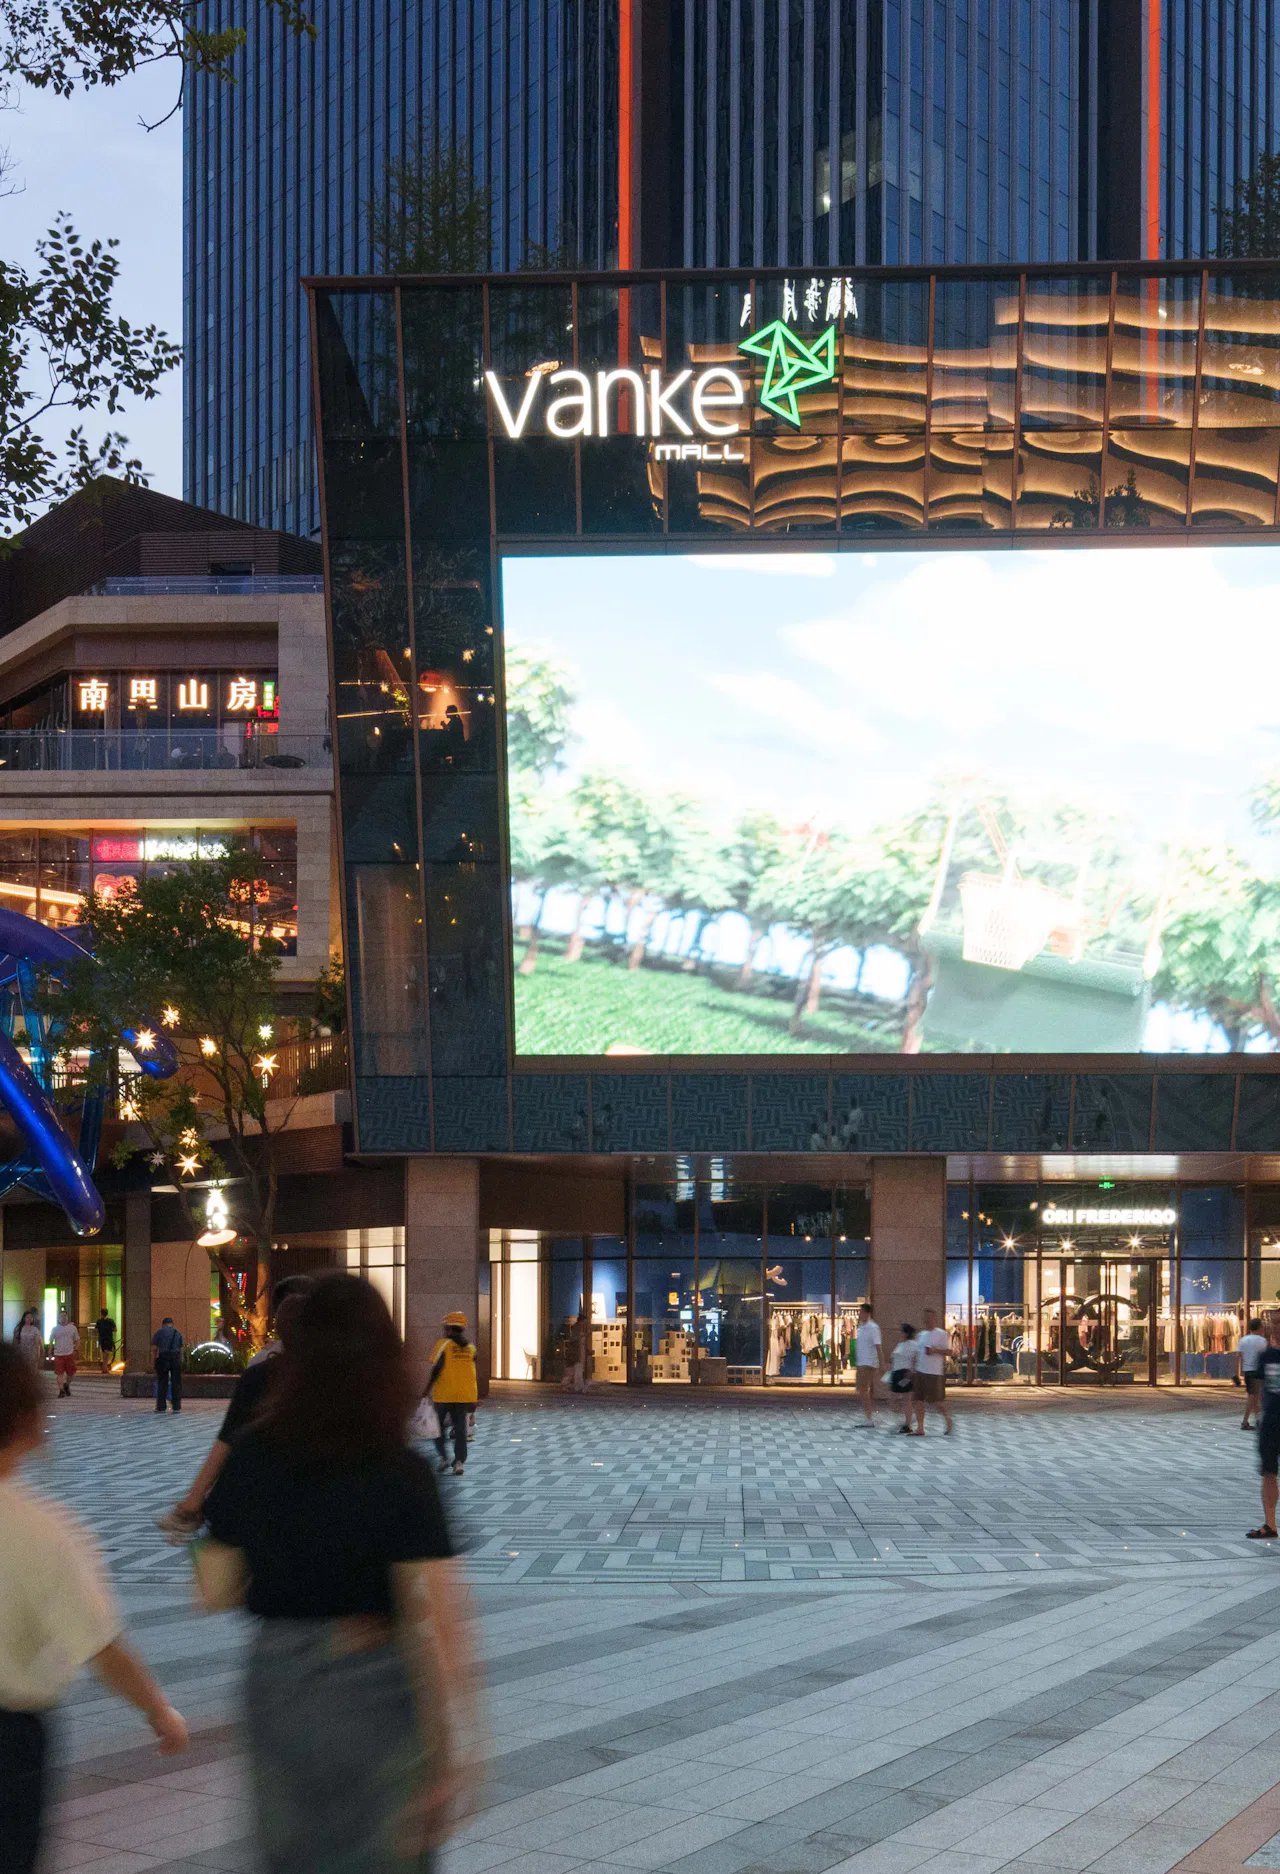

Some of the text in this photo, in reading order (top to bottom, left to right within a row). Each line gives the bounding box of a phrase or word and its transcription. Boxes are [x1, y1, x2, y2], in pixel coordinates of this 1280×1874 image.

[485, 367, 745, 439] vanke
[655, 444, 745, 461] MALL
[1042, 1208, 1073, 1224] ORI
